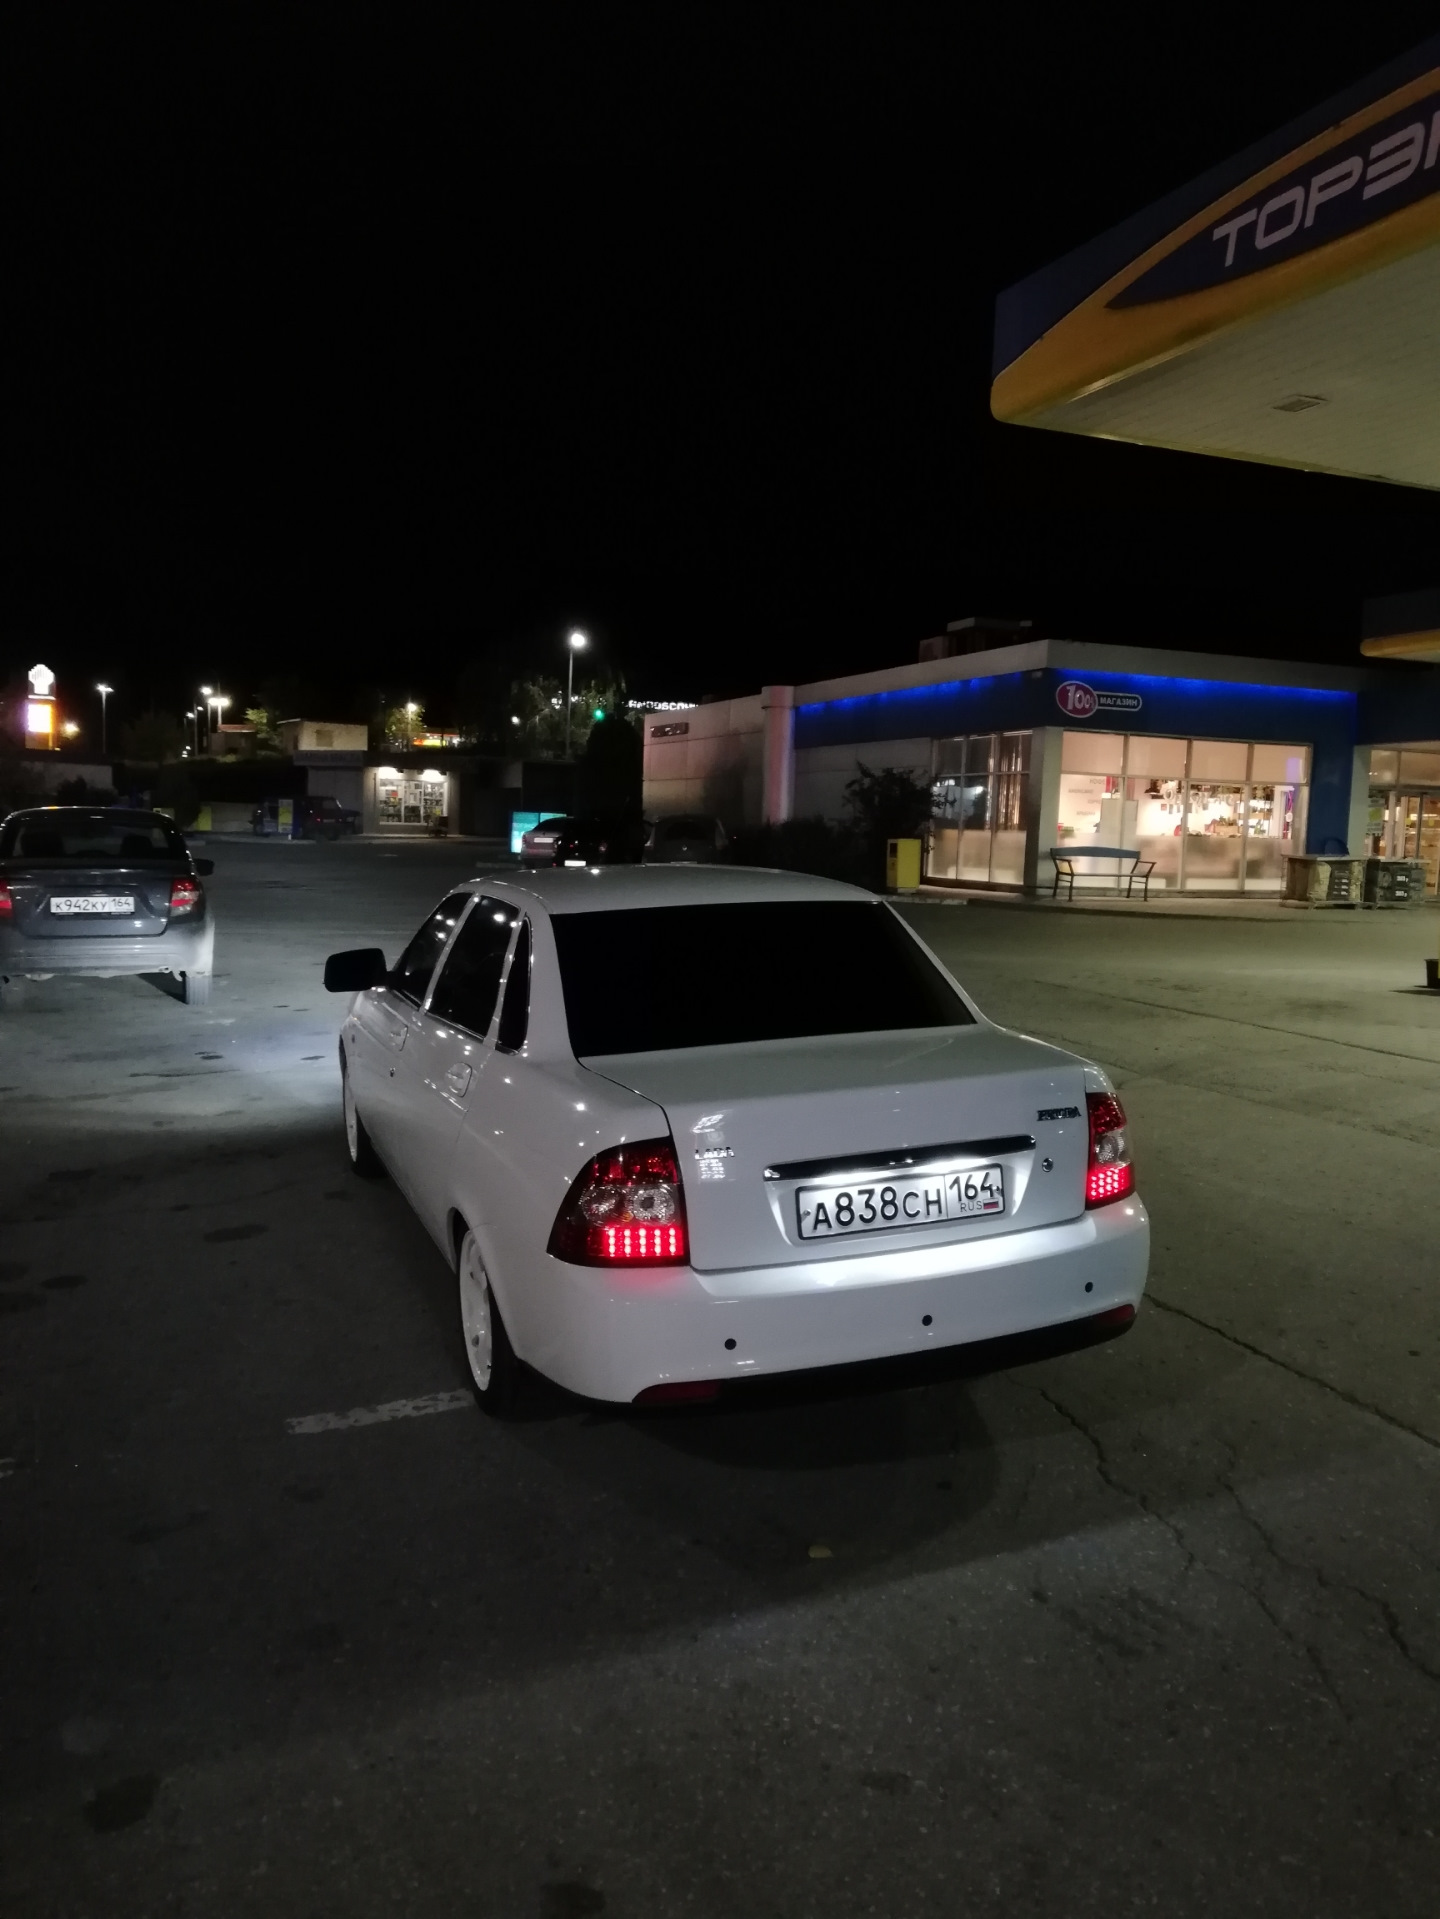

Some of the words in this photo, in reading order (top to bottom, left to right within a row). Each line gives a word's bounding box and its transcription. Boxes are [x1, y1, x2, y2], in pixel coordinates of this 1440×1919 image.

[1212, 110, 1440, 268] ТОРЭ
[1100, 696, 1138, 707] МАГАЗИН
[112, 898, 131, 908] 164
[948, 1171, 994, 1202] 164
[960, 1200, 983, 1213] RUS
